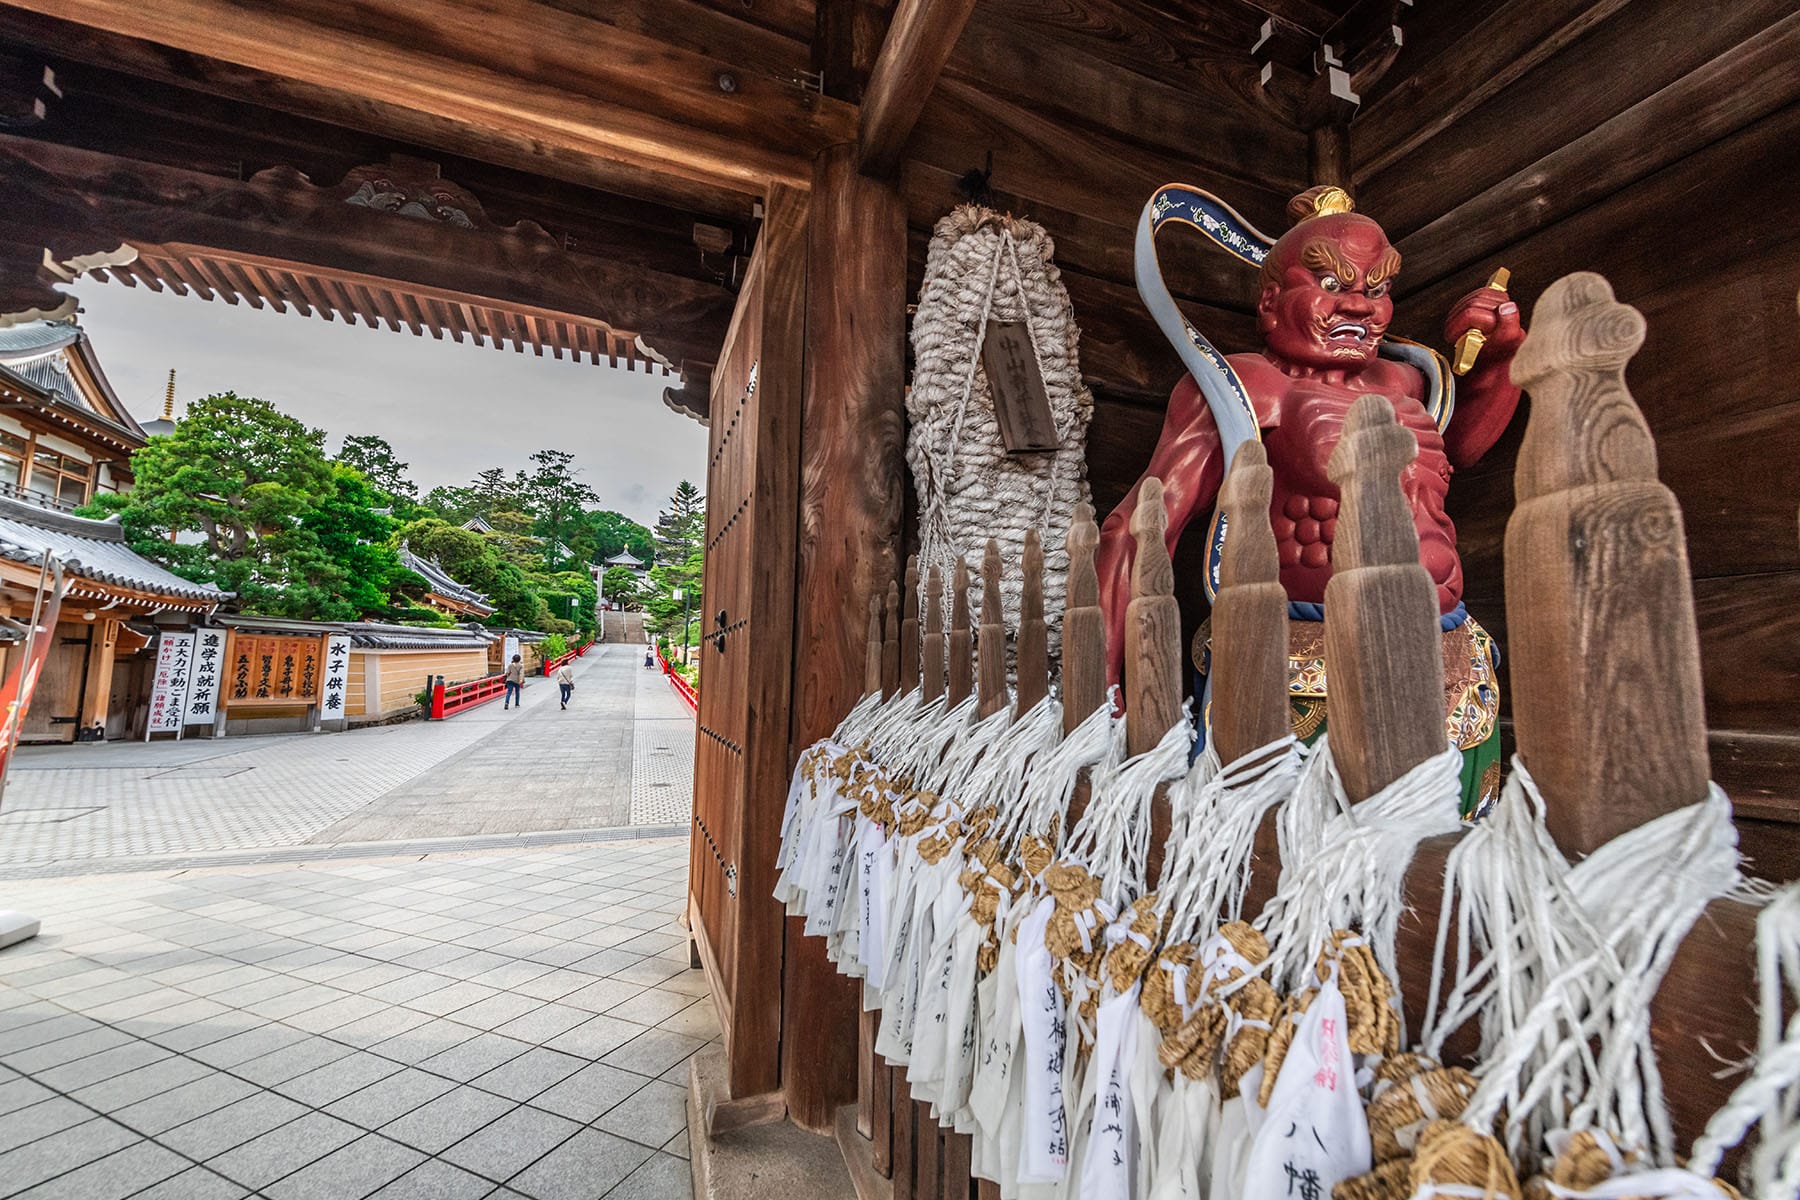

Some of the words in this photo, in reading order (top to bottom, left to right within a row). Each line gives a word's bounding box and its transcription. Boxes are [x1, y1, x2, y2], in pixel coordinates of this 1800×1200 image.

[164, 638, 190, 727] 五大力不動ごま受付
[190, 633, 219, 714] 進学成就祈願
[325, 642, 346, 710] 水子供養
